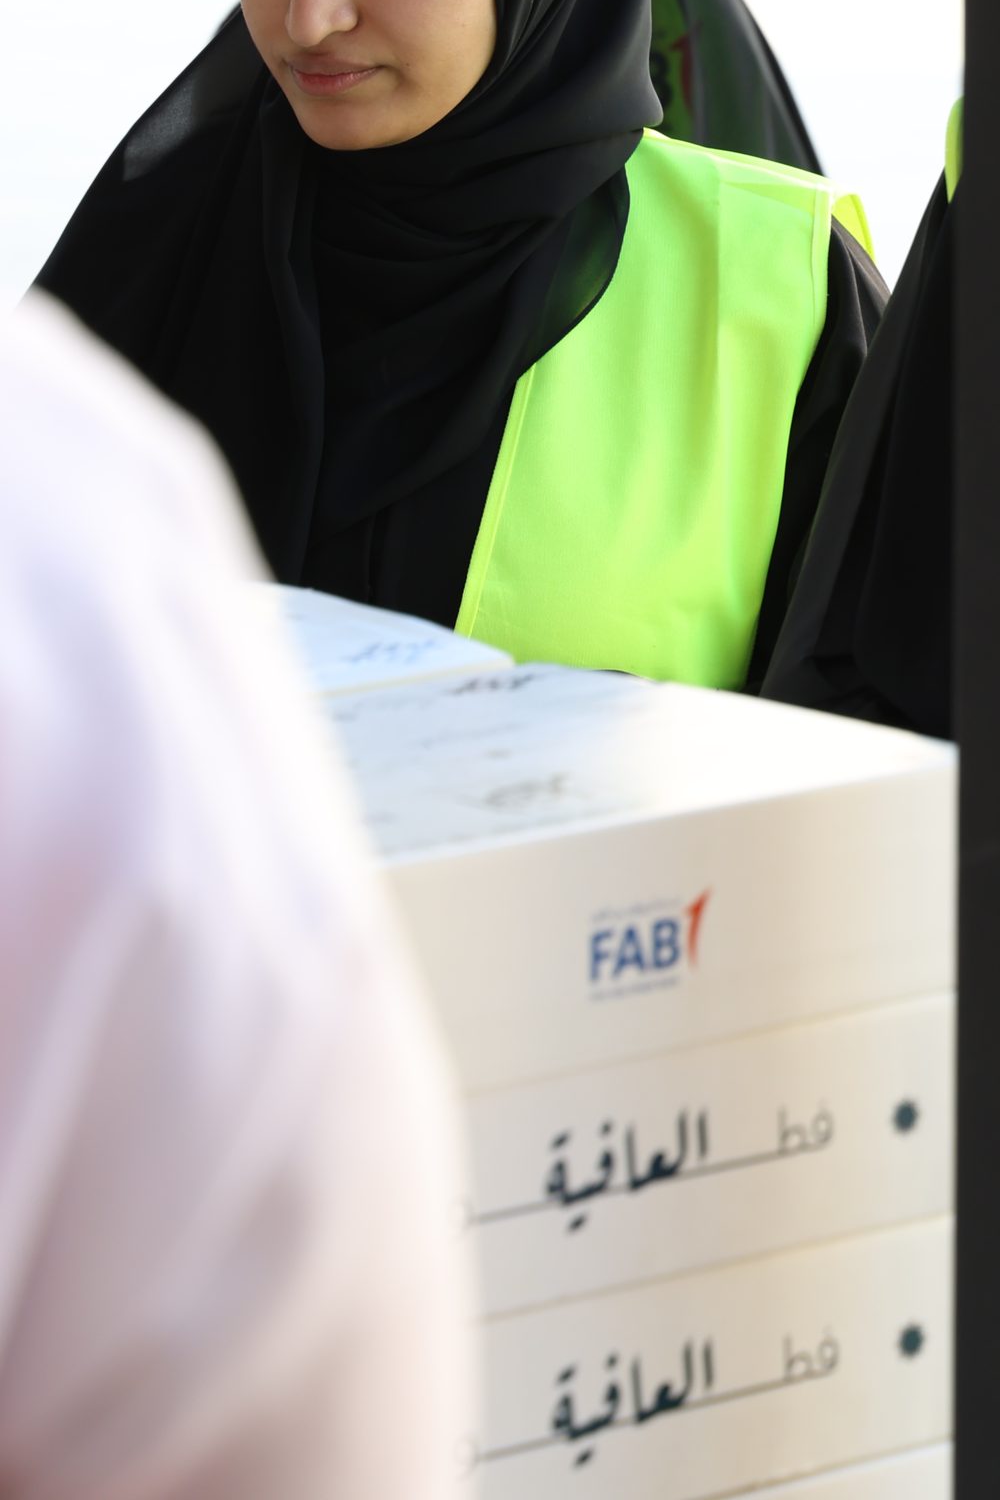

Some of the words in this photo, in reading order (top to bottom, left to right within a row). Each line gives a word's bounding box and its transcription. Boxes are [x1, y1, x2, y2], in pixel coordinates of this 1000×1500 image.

[588, 917, 681, 984] FAB
[543, 1103, 709, 1233] العافية
[550, 1337, 715, 1469] العافية
